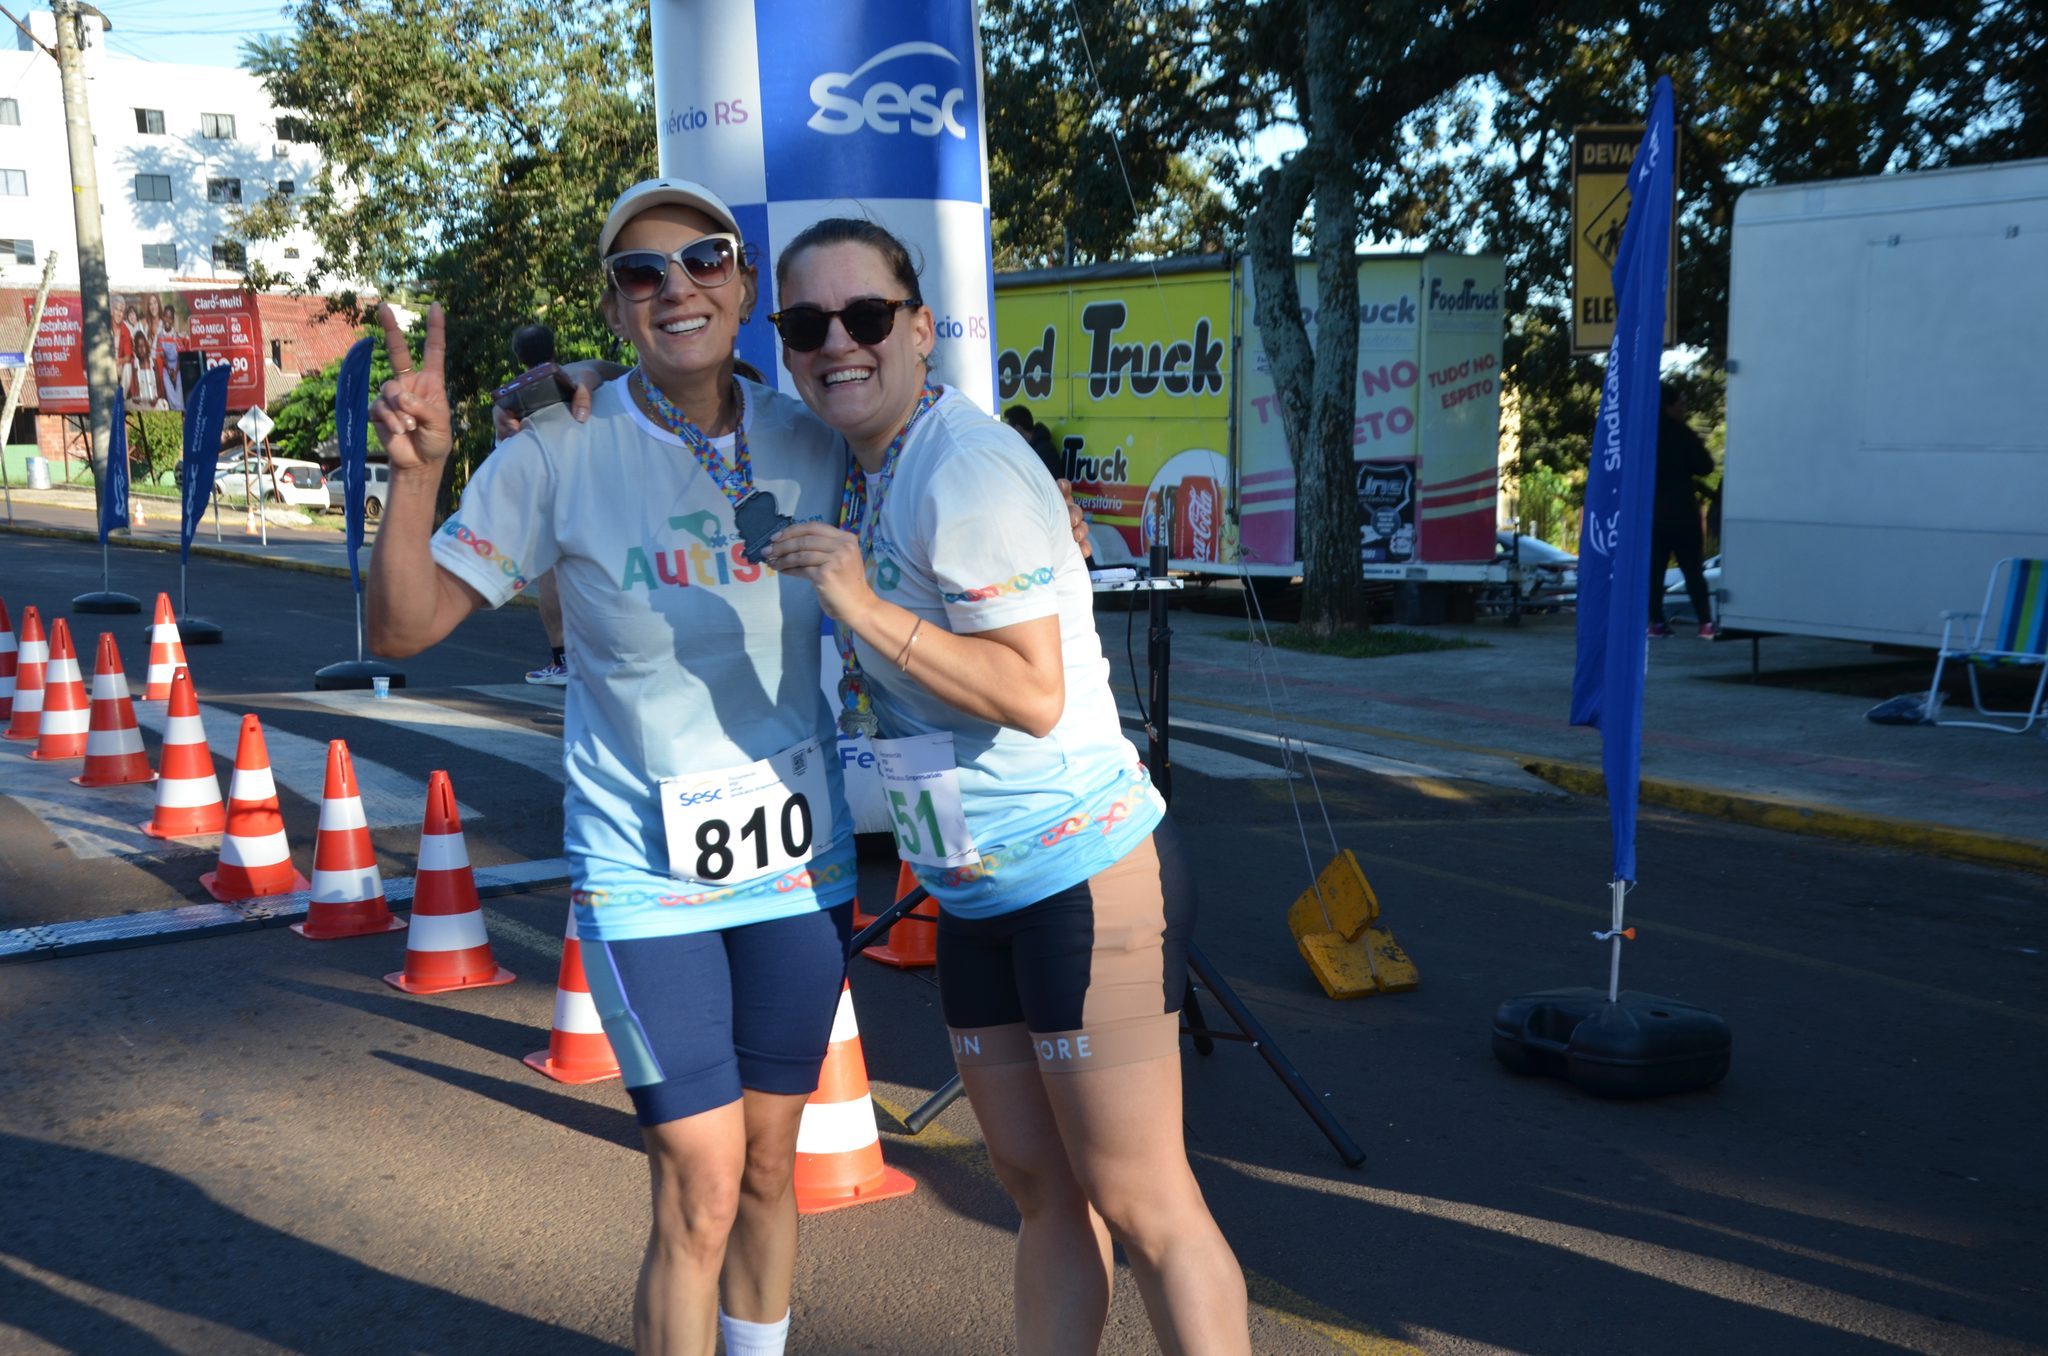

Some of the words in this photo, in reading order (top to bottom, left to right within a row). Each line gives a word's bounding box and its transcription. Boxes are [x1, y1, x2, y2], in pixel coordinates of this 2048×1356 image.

[715, 99, 748, 126] RS
[807, 72, 966, 139] Sesc
[969, 316, 987, 339] RS
[1583, 297, 1616, 324] ELE
[1081, 300, 1224, 402] Truck
[1362, 359, 1418, 397] NO
[1441, 378, 1493, 410] ESPETO
[1354, 406, 1414, 445] ETO
[1063, 434, 1128, 484] Truck
[839, 747, 876, 770] Fe
[695, 792, 813, 880] 810
[888, 790, 947, 858] 51
[954, 1035, 981, 1056] UN
[1040, 1035, 1092, 1061] ORE
